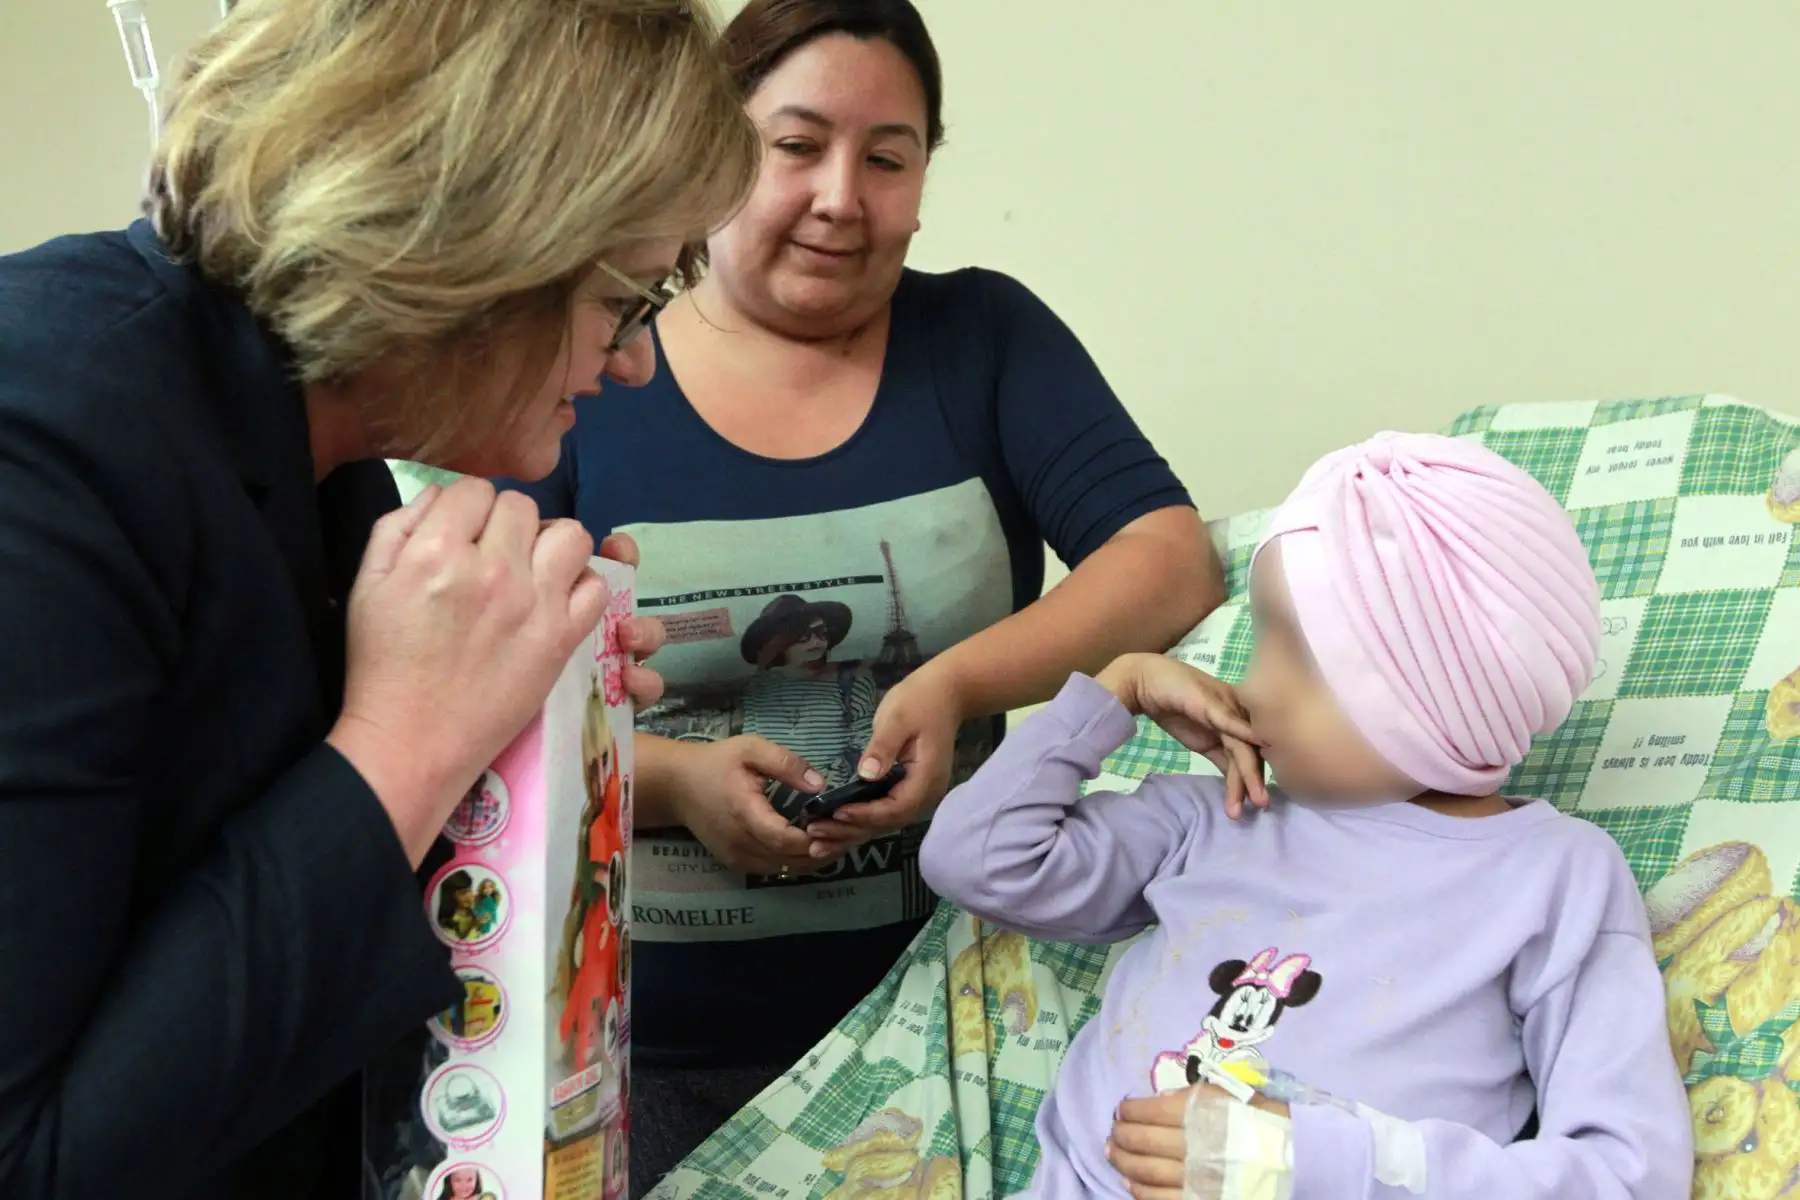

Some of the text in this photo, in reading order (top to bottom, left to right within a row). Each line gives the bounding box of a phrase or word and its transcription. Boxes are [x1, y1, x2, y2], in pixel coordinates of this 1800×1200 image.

[1680, 536, 1699, 549] you
[1702, 535, 1724, 548] with
[1728, 534, 1750, 546] love
[659, 595, 687, 605] THE
[692, 589, 728, 602] NEW
[1601, 757, 1636, 770] always
[1653, 755, 1677, 767] bear
[1680, 752, 1710, 767] Teddy
[652, 844, 714, 858] BEAUTI
